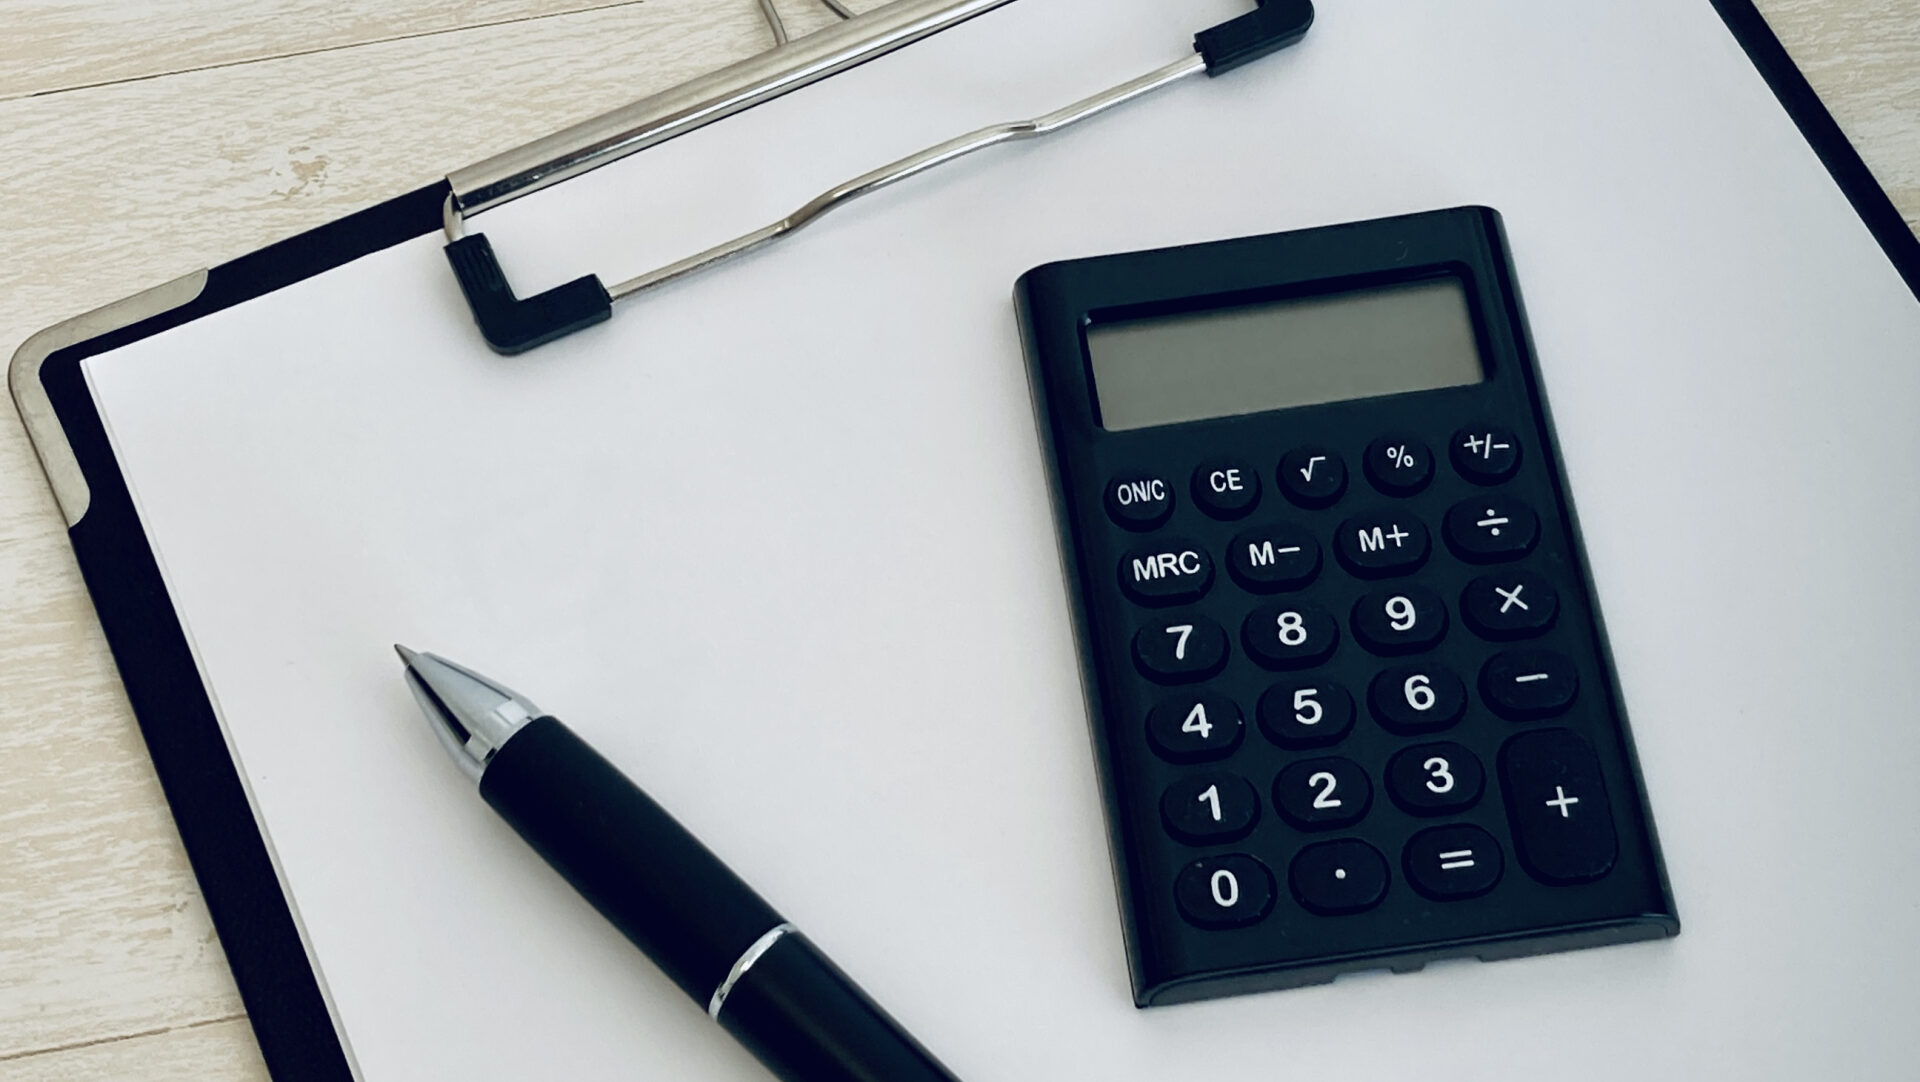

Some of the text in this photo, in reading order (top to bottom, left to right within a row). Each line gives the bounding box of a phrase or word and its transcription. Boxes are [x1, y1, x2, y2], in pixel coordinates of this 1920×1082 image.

[1386, 444, 1414, 469] %
[1117, 479, 1166, 506] ON/C
[1209, 468, 1244, 493] CE
[1358, 523, 1410, 553] M+
[1132, 550, 1201, 582] MRC
[1276, 611, 1307, 646] 8
[1385, 596, 1417, 631] 9
[1165, 624, 1194, 660] 7
[1293, 688, 1323, 725] 5
[1404, 674, 1436, 711] 6
[1181, 702, 1213, 739] 4
[1308, 771, 1342, 809] 2
[1423, 757, 1455, 794] 3
[1198, 784, 1222, 821] 1
[1210, 869, 1239, 907] 0
